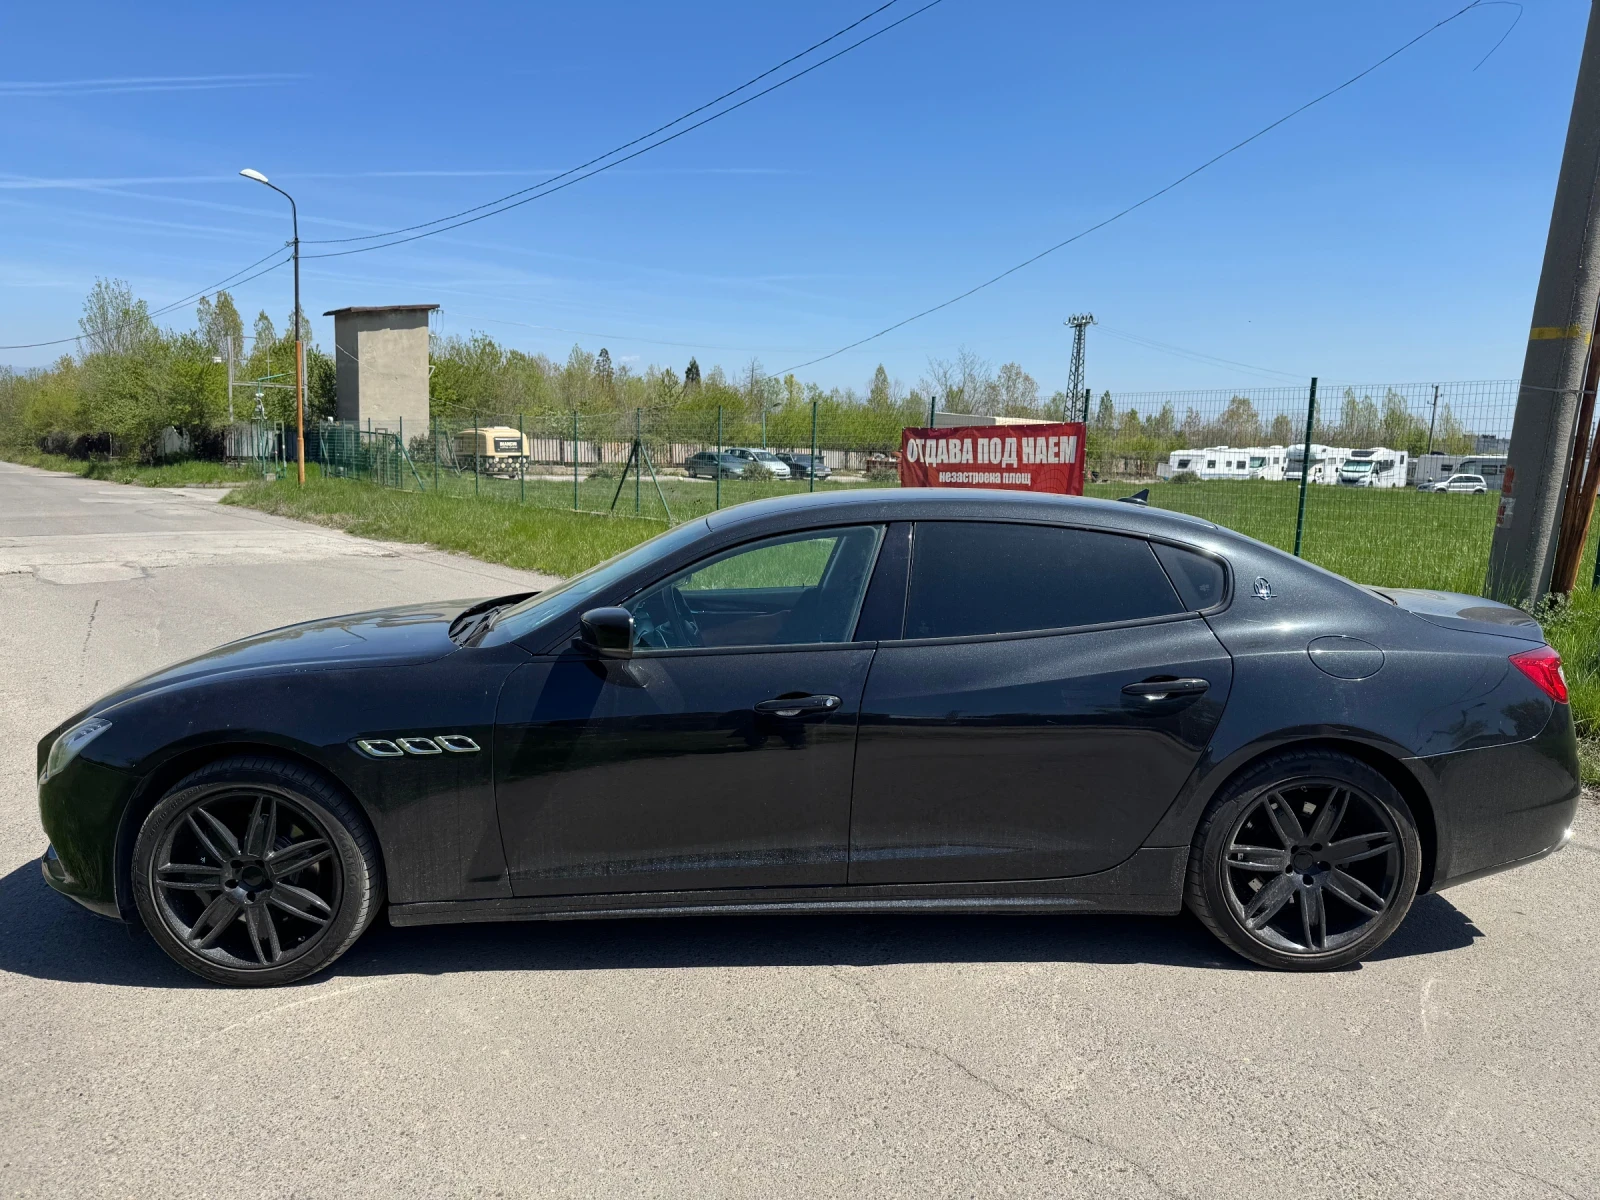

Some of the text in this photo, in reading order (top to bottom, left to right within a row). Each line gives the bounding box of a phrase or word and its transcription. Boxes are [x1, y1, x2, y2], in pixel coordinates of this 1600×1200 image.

[906, 435, 1077, 468] ОТДАВА ПОД НАЕМ
[939, 471, 1032, 486] незастроена площ
